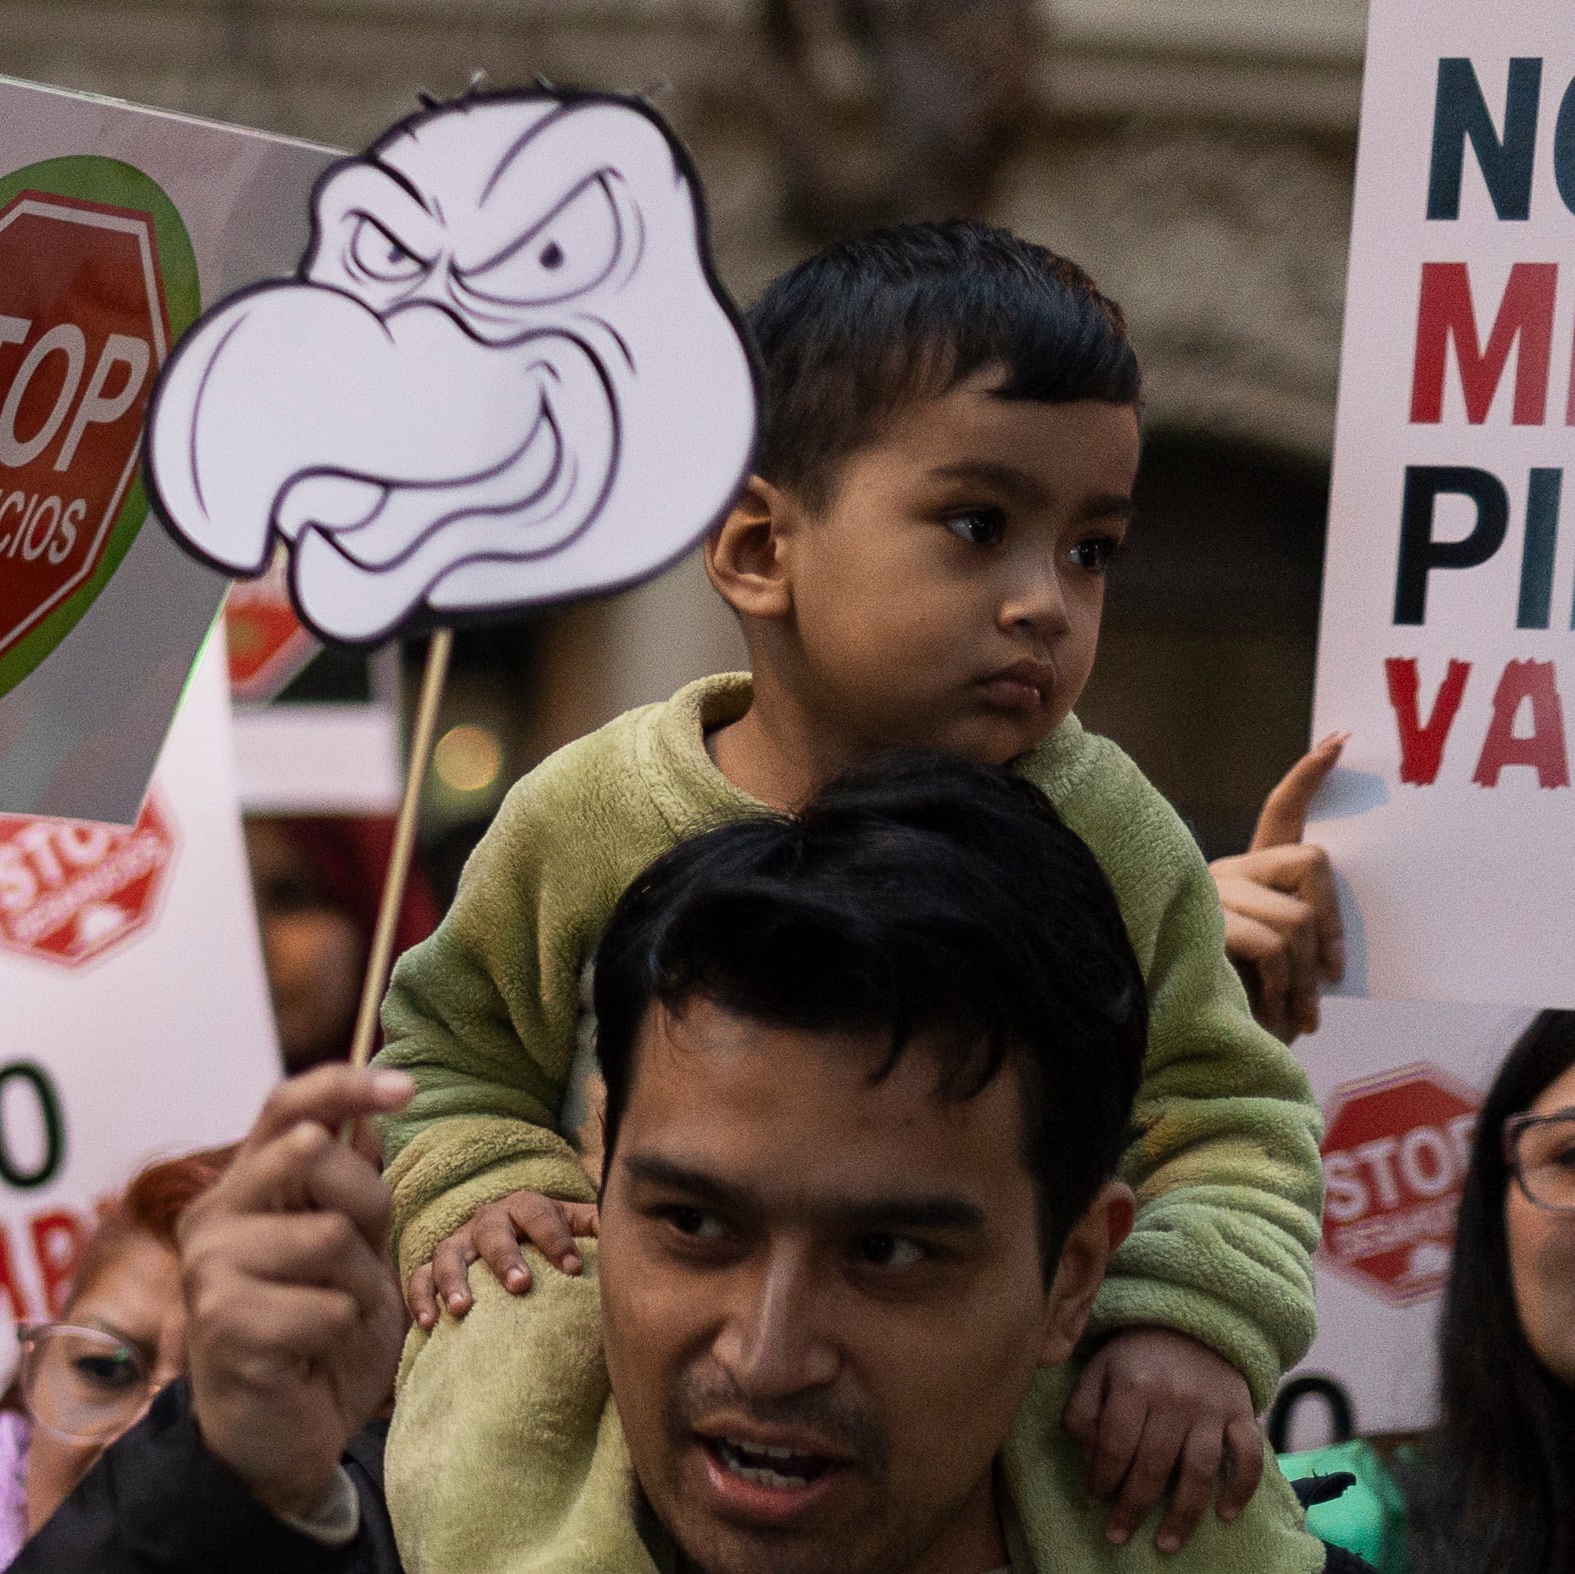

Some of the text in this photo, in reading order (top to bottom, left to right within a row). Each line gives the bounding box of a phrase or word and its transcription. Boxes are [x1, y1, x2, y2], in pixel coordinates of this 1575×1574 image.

[1425, 57, 1575, 221] N
[1408, 262, 1575, 426] M
[1392, 465, 1575, 630] PI
[1385, 656, 1570, 789] VA
